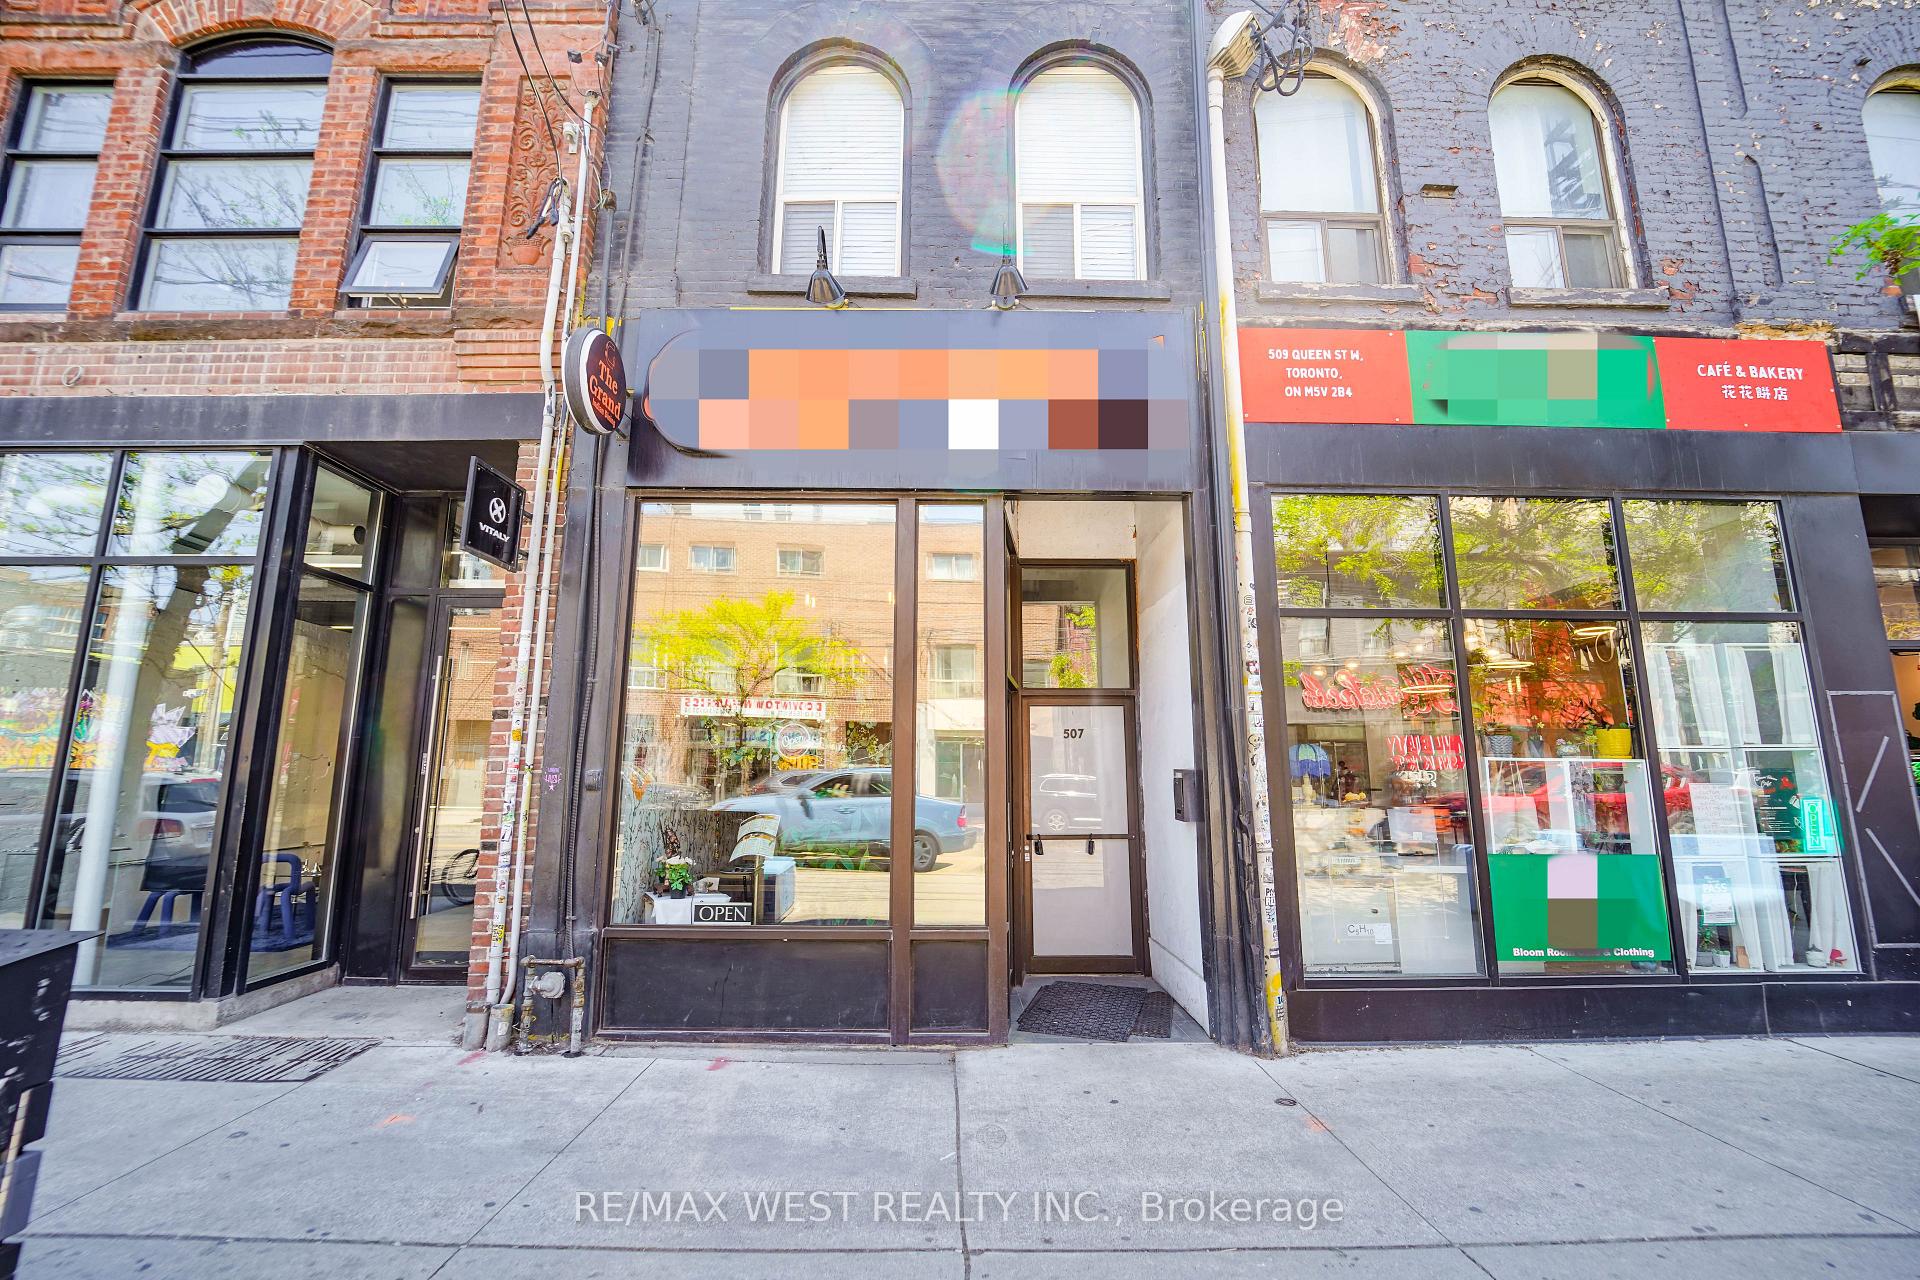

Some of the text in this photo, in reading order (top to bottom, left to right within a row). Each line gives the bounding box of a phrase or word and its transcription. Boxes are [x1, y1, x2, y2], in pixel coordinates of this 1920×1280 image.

[1268, 349, 1288, 360] 509
[1291, 349, 1332, 360] QUEEN
[1334, 349, 1348, 360] ST
[598, 359, 618, 395] The
[1697, 361, 1803, 380] CAFÉ & BAKERY
[589, 374, 621, 421] Grand
[1284, 386, 1353, 398] ON M5V 2B4
[479, 521, 510, 543] VITALY
[1063, 728, 1084, 739] 507
[1807, 803, 1820, 845] OPEN
[699, 905, 747, 921] OPEN
[1512, 947, 1545, 957] Bloom
[1614, 948, 1655, 958] Clothing
